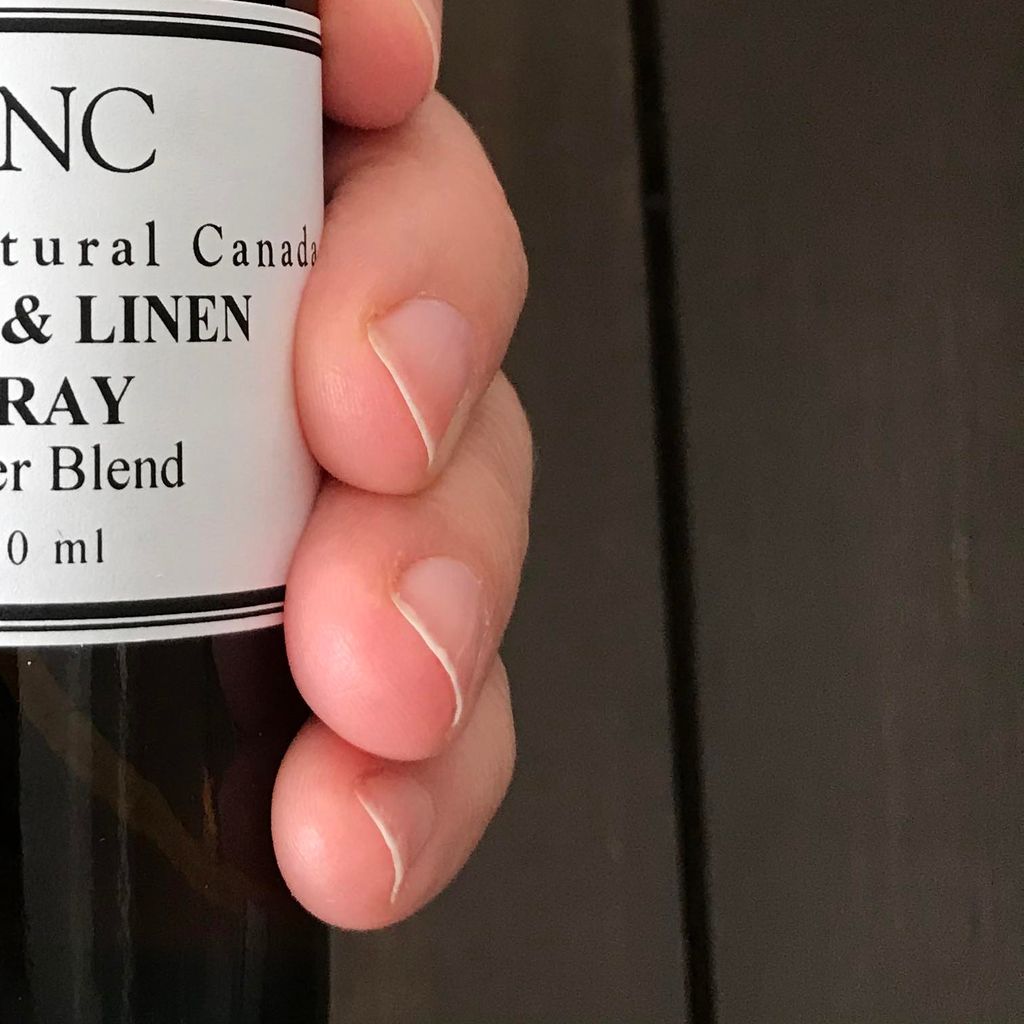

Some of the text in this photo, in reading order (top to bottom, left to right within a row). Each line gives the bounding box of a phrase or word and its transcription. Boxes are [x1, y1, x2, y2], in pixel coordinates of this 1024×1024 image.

[193, 222, 318, 268] Canada
[2, 295, 53, 344] &
[76, 295, 253, 343] LINEN
[51, 441, 186, 492] Blend
[55, 528, 105, 565] ml
